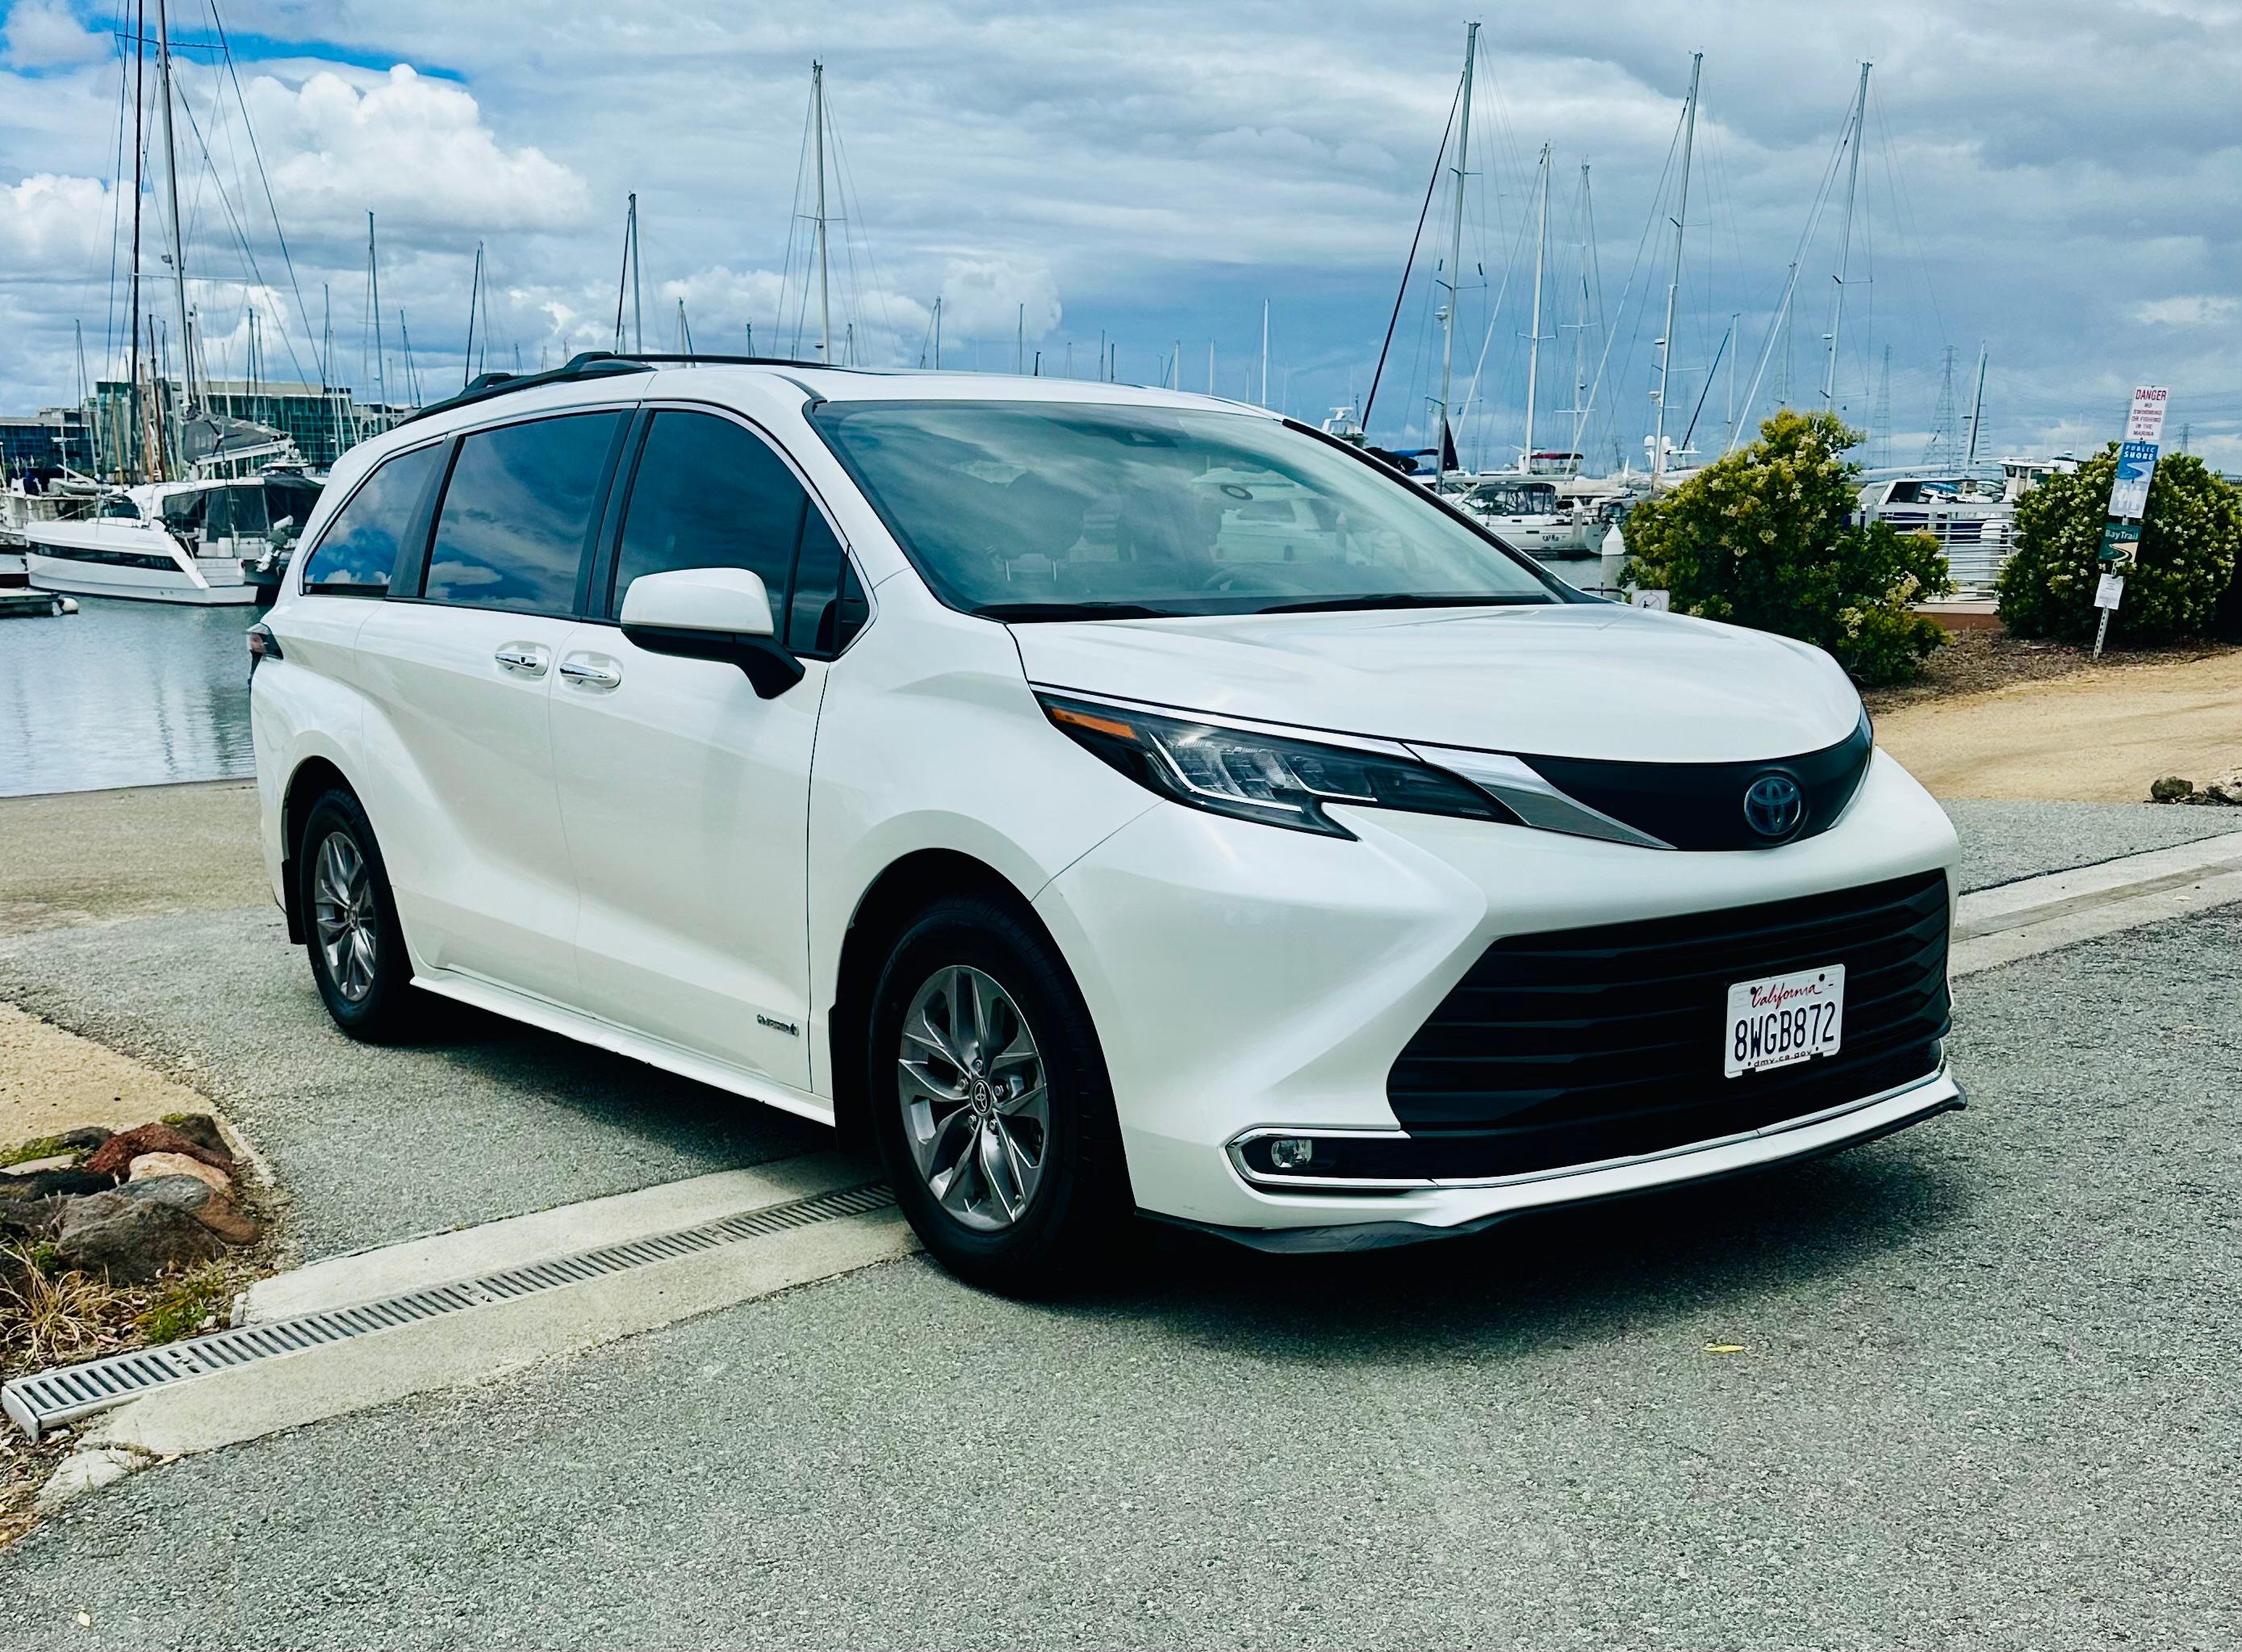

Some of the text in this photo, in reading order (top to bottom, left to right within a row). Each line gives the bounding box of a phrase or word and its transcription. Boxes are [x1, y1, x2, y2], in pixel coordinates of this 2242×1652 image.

[2135, 389, 2167, 400] DANGER
[2125, 445, 2155, 453] PUBLIC
[2123, 451, 2154, 460] SHORE
[2105, 529, 2139, 540] Bay Trail
[1751, 982, 1822, 1010] California
[1734, 1001, 1836, 1062] 8WGB872
[1754, 1050, 1813, 1068] dmv.ca.gov
